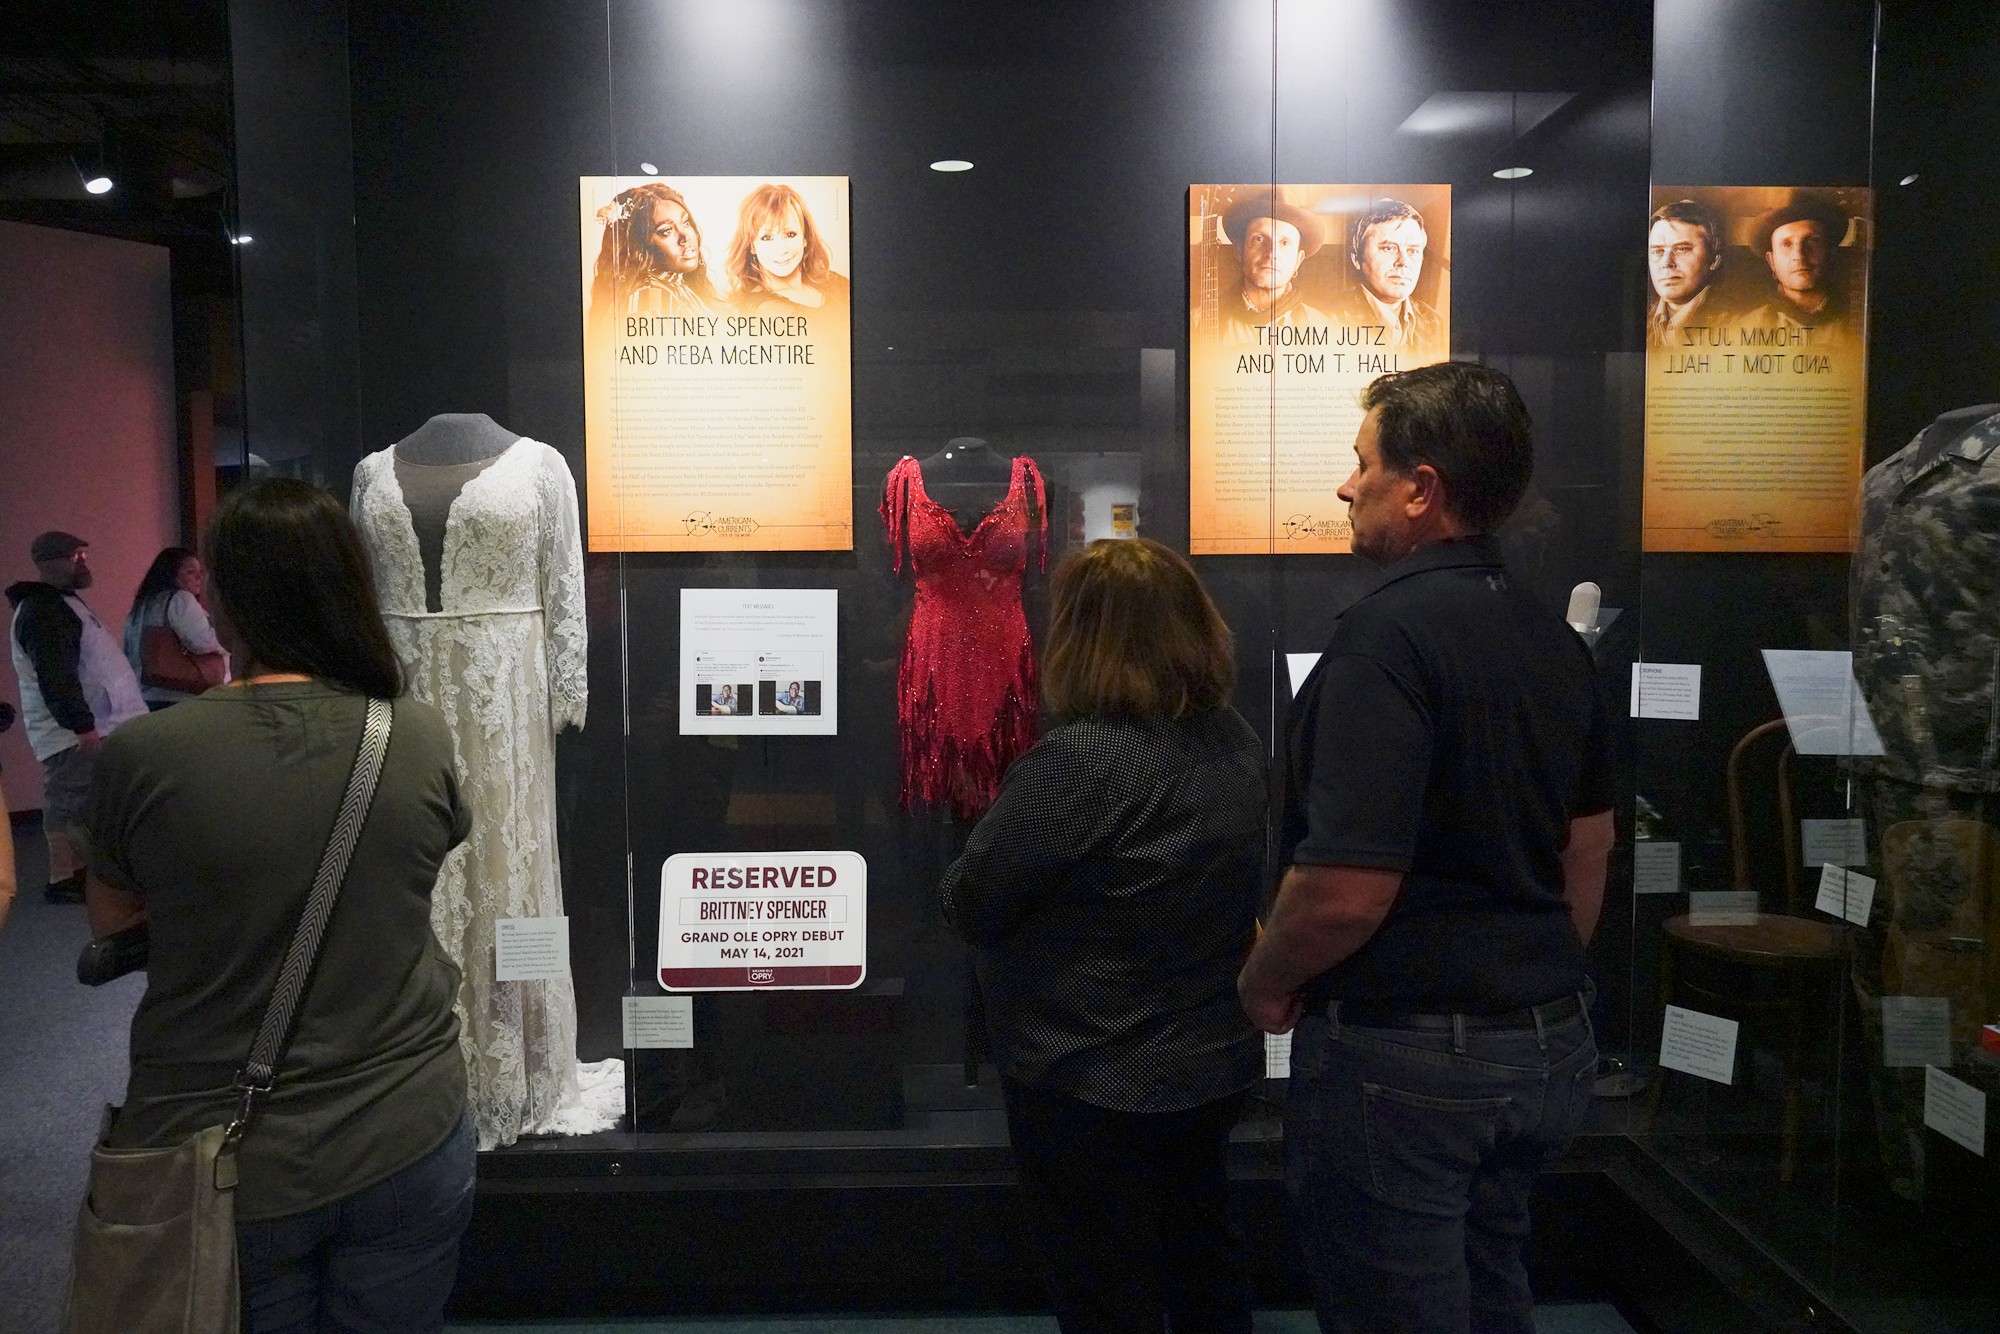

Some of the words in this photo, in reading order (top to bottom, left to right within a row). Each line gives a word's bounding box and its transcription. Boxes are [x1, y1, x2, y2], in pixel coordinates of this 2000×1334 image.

[626, 316, 718, 337] BRITTNEY
[727, 316, 808, 336] SPENCER
[1255, 326, 1328, 346] THOMM
[1336, 325, 1386, 346] JUTZ
[620, 345, 658, 365] AND
[667, 345, 713, 365] REBA
[721, 345, 815, 365] McENTIRE
[1236, 354, 1274, 374] AND
[1282, 354, 1324, 374] TOM
[1333, 354, 1350, 373] T.
[1358, 354, 1402, 373] HALL
[717, 525, 752, 533] CURRENTS
[1317, 520, 1350, 528] AMERICAN
[1317, 528, 1350, 536] CURRENTS
[691, 865, 837, 890] RESERVED
[700, 901, 763, 921] BRITTNEY
[766, 899, 827, 920] SPENCER
[681, 932, 729, 943] GRAND
[733, 931, 757, 943] OLE
[762, 931, 798, 942] OPRY
[802, 930, 845, 942] DEBUT
[720, 948, 749, 959] MAY
[753, 948, 771, 960] 14,
[775, 947, 804, 958] 2021
[751, 972, 773, 980] OPRY
